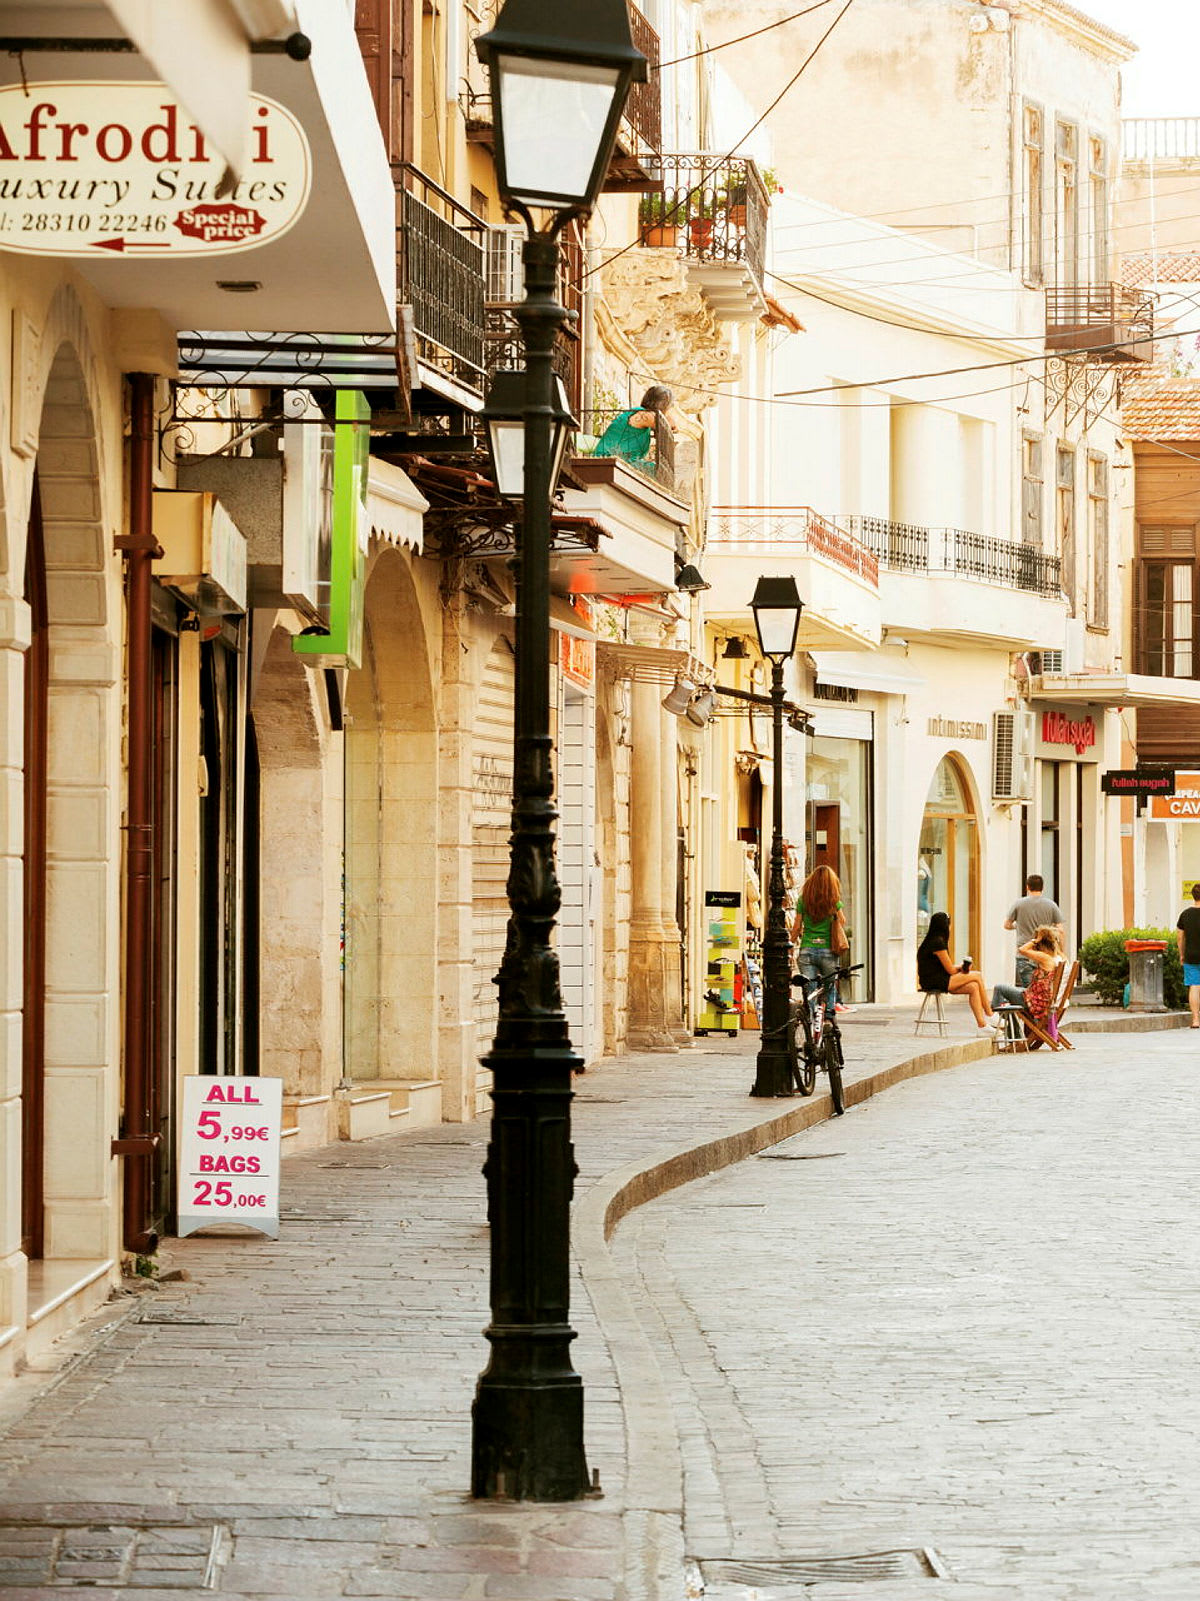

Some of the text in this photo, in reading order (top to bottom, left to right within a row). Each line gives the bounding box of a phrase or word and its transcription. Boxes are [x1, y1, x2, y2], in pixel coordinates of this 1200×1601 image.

[0, 103, 274, 163] frodii
[0, 168, 287, 207] uxury Sutes
[22, 213, 90, 232] 28310
[99, 213, 167, 233] 22246
[181, 210, 256, 229] Special
[203, 223, 256, 241] price
[206, 1085, 260, 1103] ALL
[197, 1111, 269, 1143] 5,99€
[199, 1154, 261, 1174] BAGS
[193, 1180, 266, 1209] 25,00€
